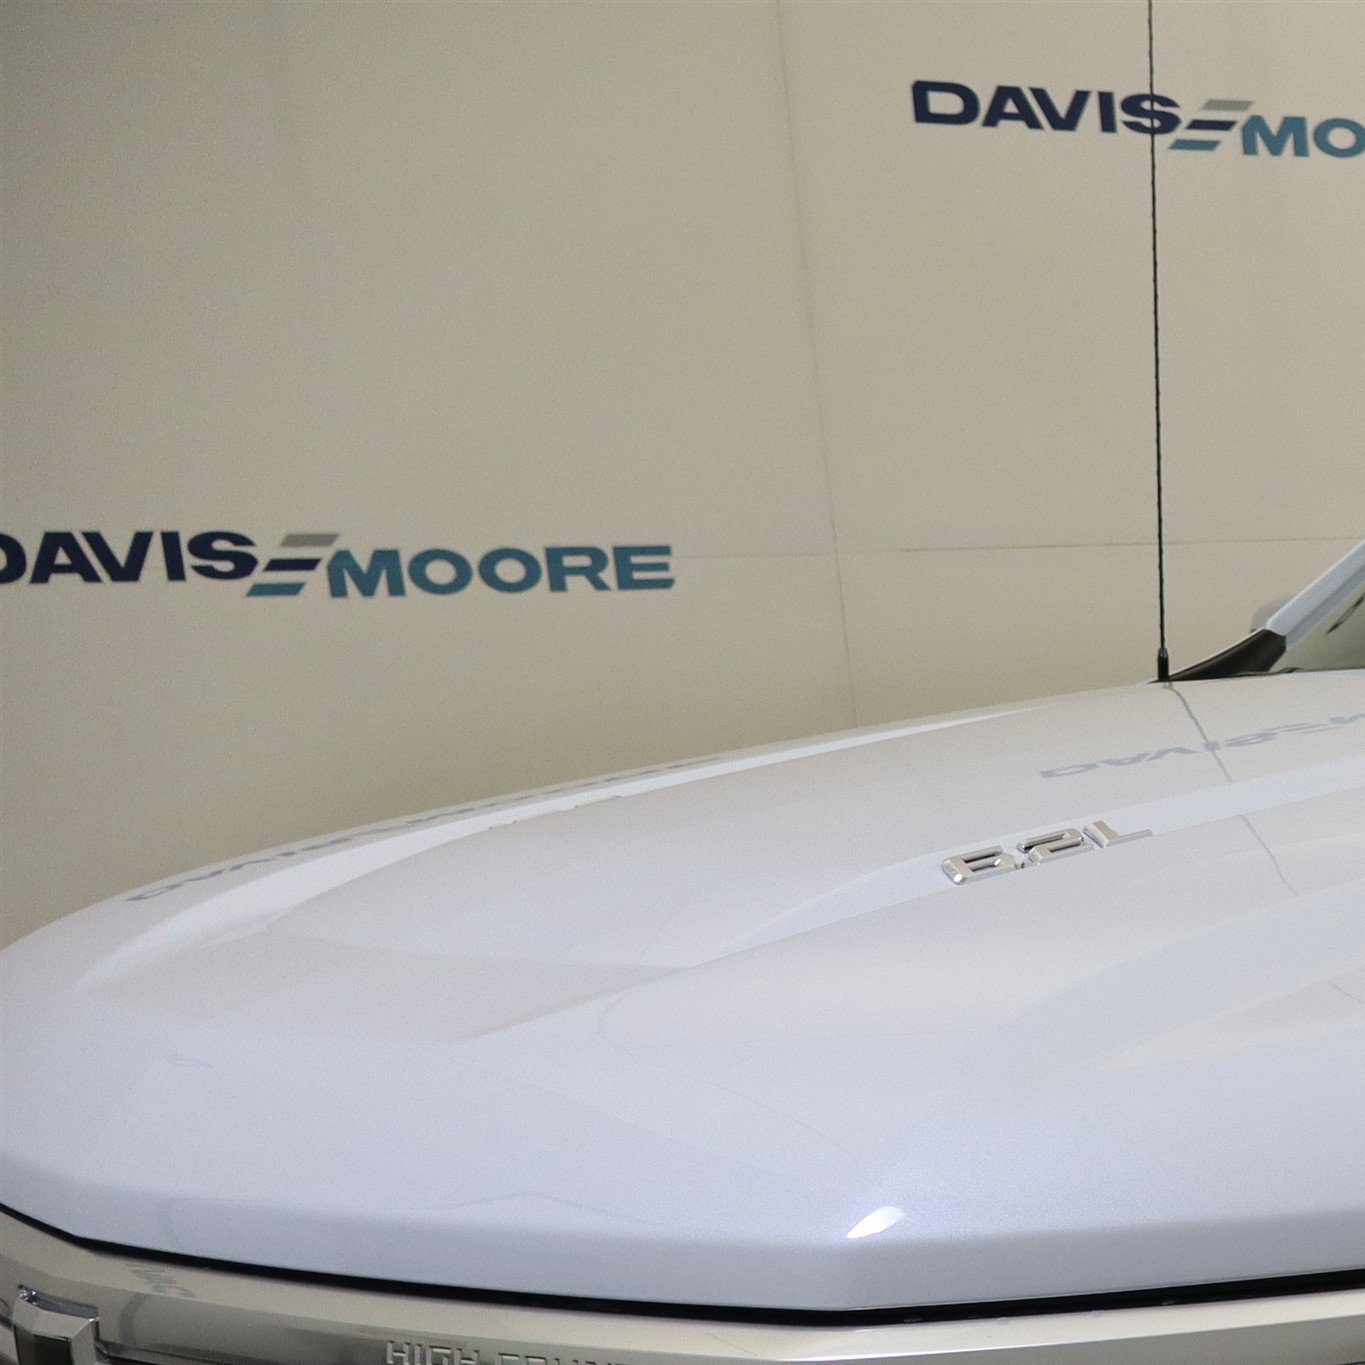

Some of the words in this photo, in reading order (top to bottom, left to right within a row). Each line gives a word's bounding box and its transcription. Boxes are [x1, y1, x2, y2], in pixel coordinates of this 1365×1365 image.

[911, 80, 1181, 136] DAVIS
[326, 544, 676, 598] MOORE
[941, 820, 1154, 885] 6.2L
